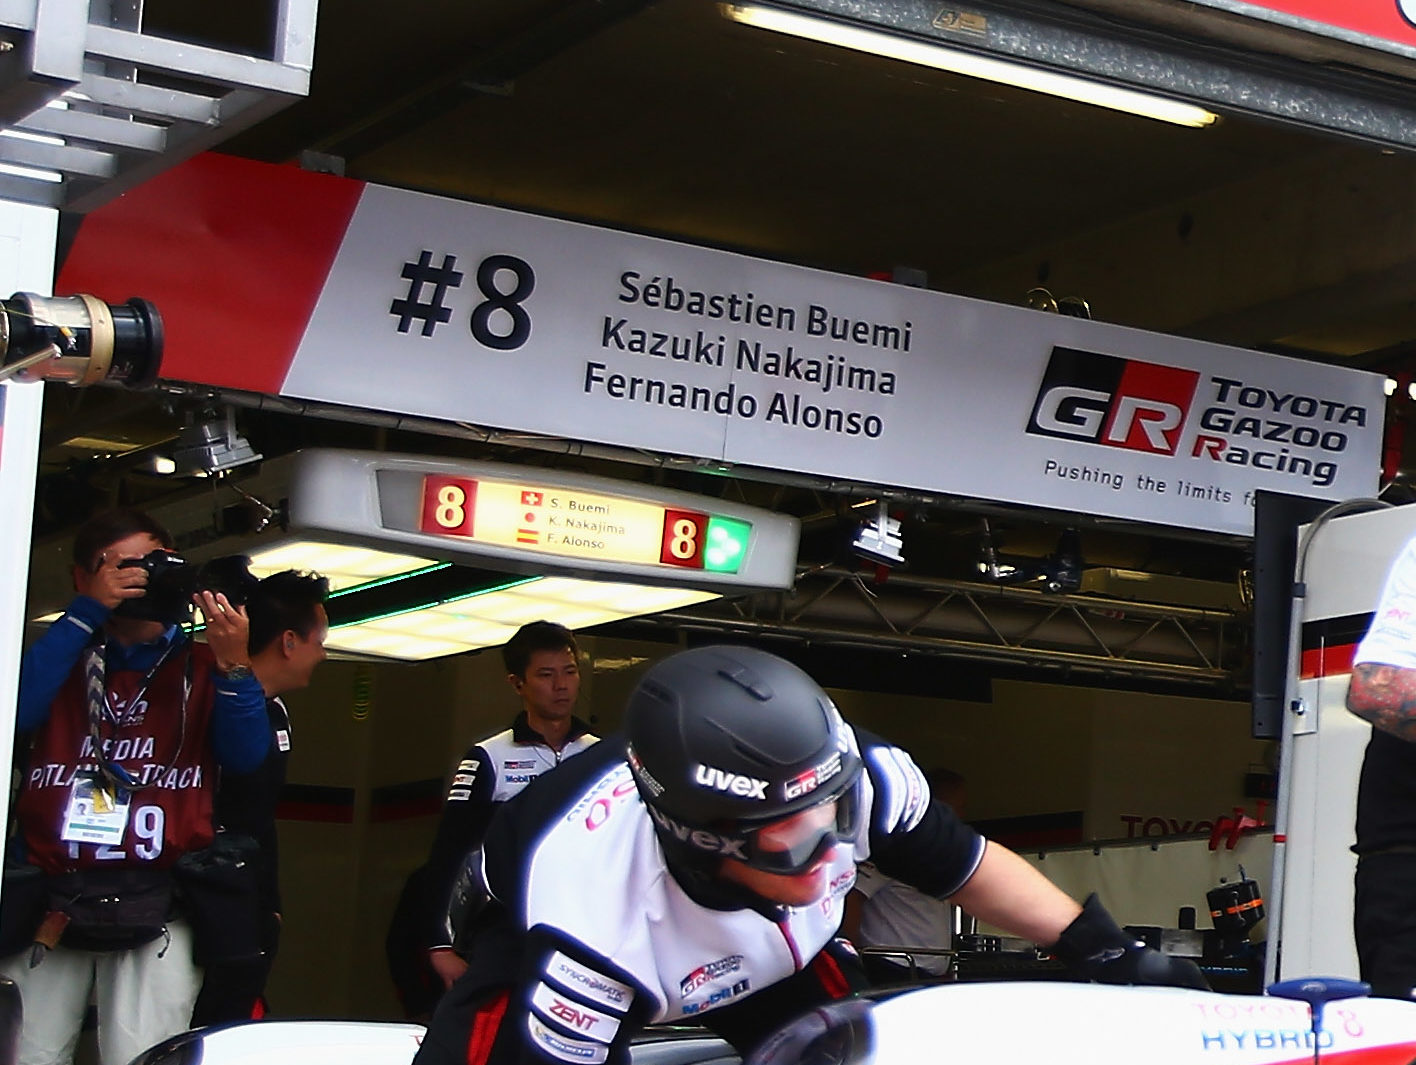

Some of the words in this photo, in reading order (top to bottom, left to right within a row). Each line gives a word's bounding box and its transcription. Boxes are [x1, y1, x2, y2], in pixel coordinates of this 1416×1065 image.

[389, 250, 538, 353] #8
[618, 269, 796, 332] Sébastien
[805, 304, 913, 353] Buemi
[600, 315, 726, 368] Kazuki
[735, 338, 898, 396] Nakajima
[583, 360, 758, 419] Fernando
[765, 393, 885, 441] Alonso
[1034, 384, 1183, 452] GR
[1210, 375, 1368, 428] TOYOTA
[1199, 406, 1349, 453] GAZOO
[1044, 459, 1125, 491] Pushing
[1137, 473, 1167, 494] the
[1177, 480, 1233, 504] limits
[1190, 433, 1339, 488] Racing
[434, 484, 466, 528] 8
[550, 496, 563, 509] S.
[567, 499, 611, 516] Buemi
[565, 516, 627, 535] Nakajima
[561, 535, 606, 550] Alonso
[669, 518, 698, 559] 8
[695, 764, 771, 801] uvex
[549, 998, 599, 1031] ZENT
[1202, 1028, 1335, 1051] HYBRID
